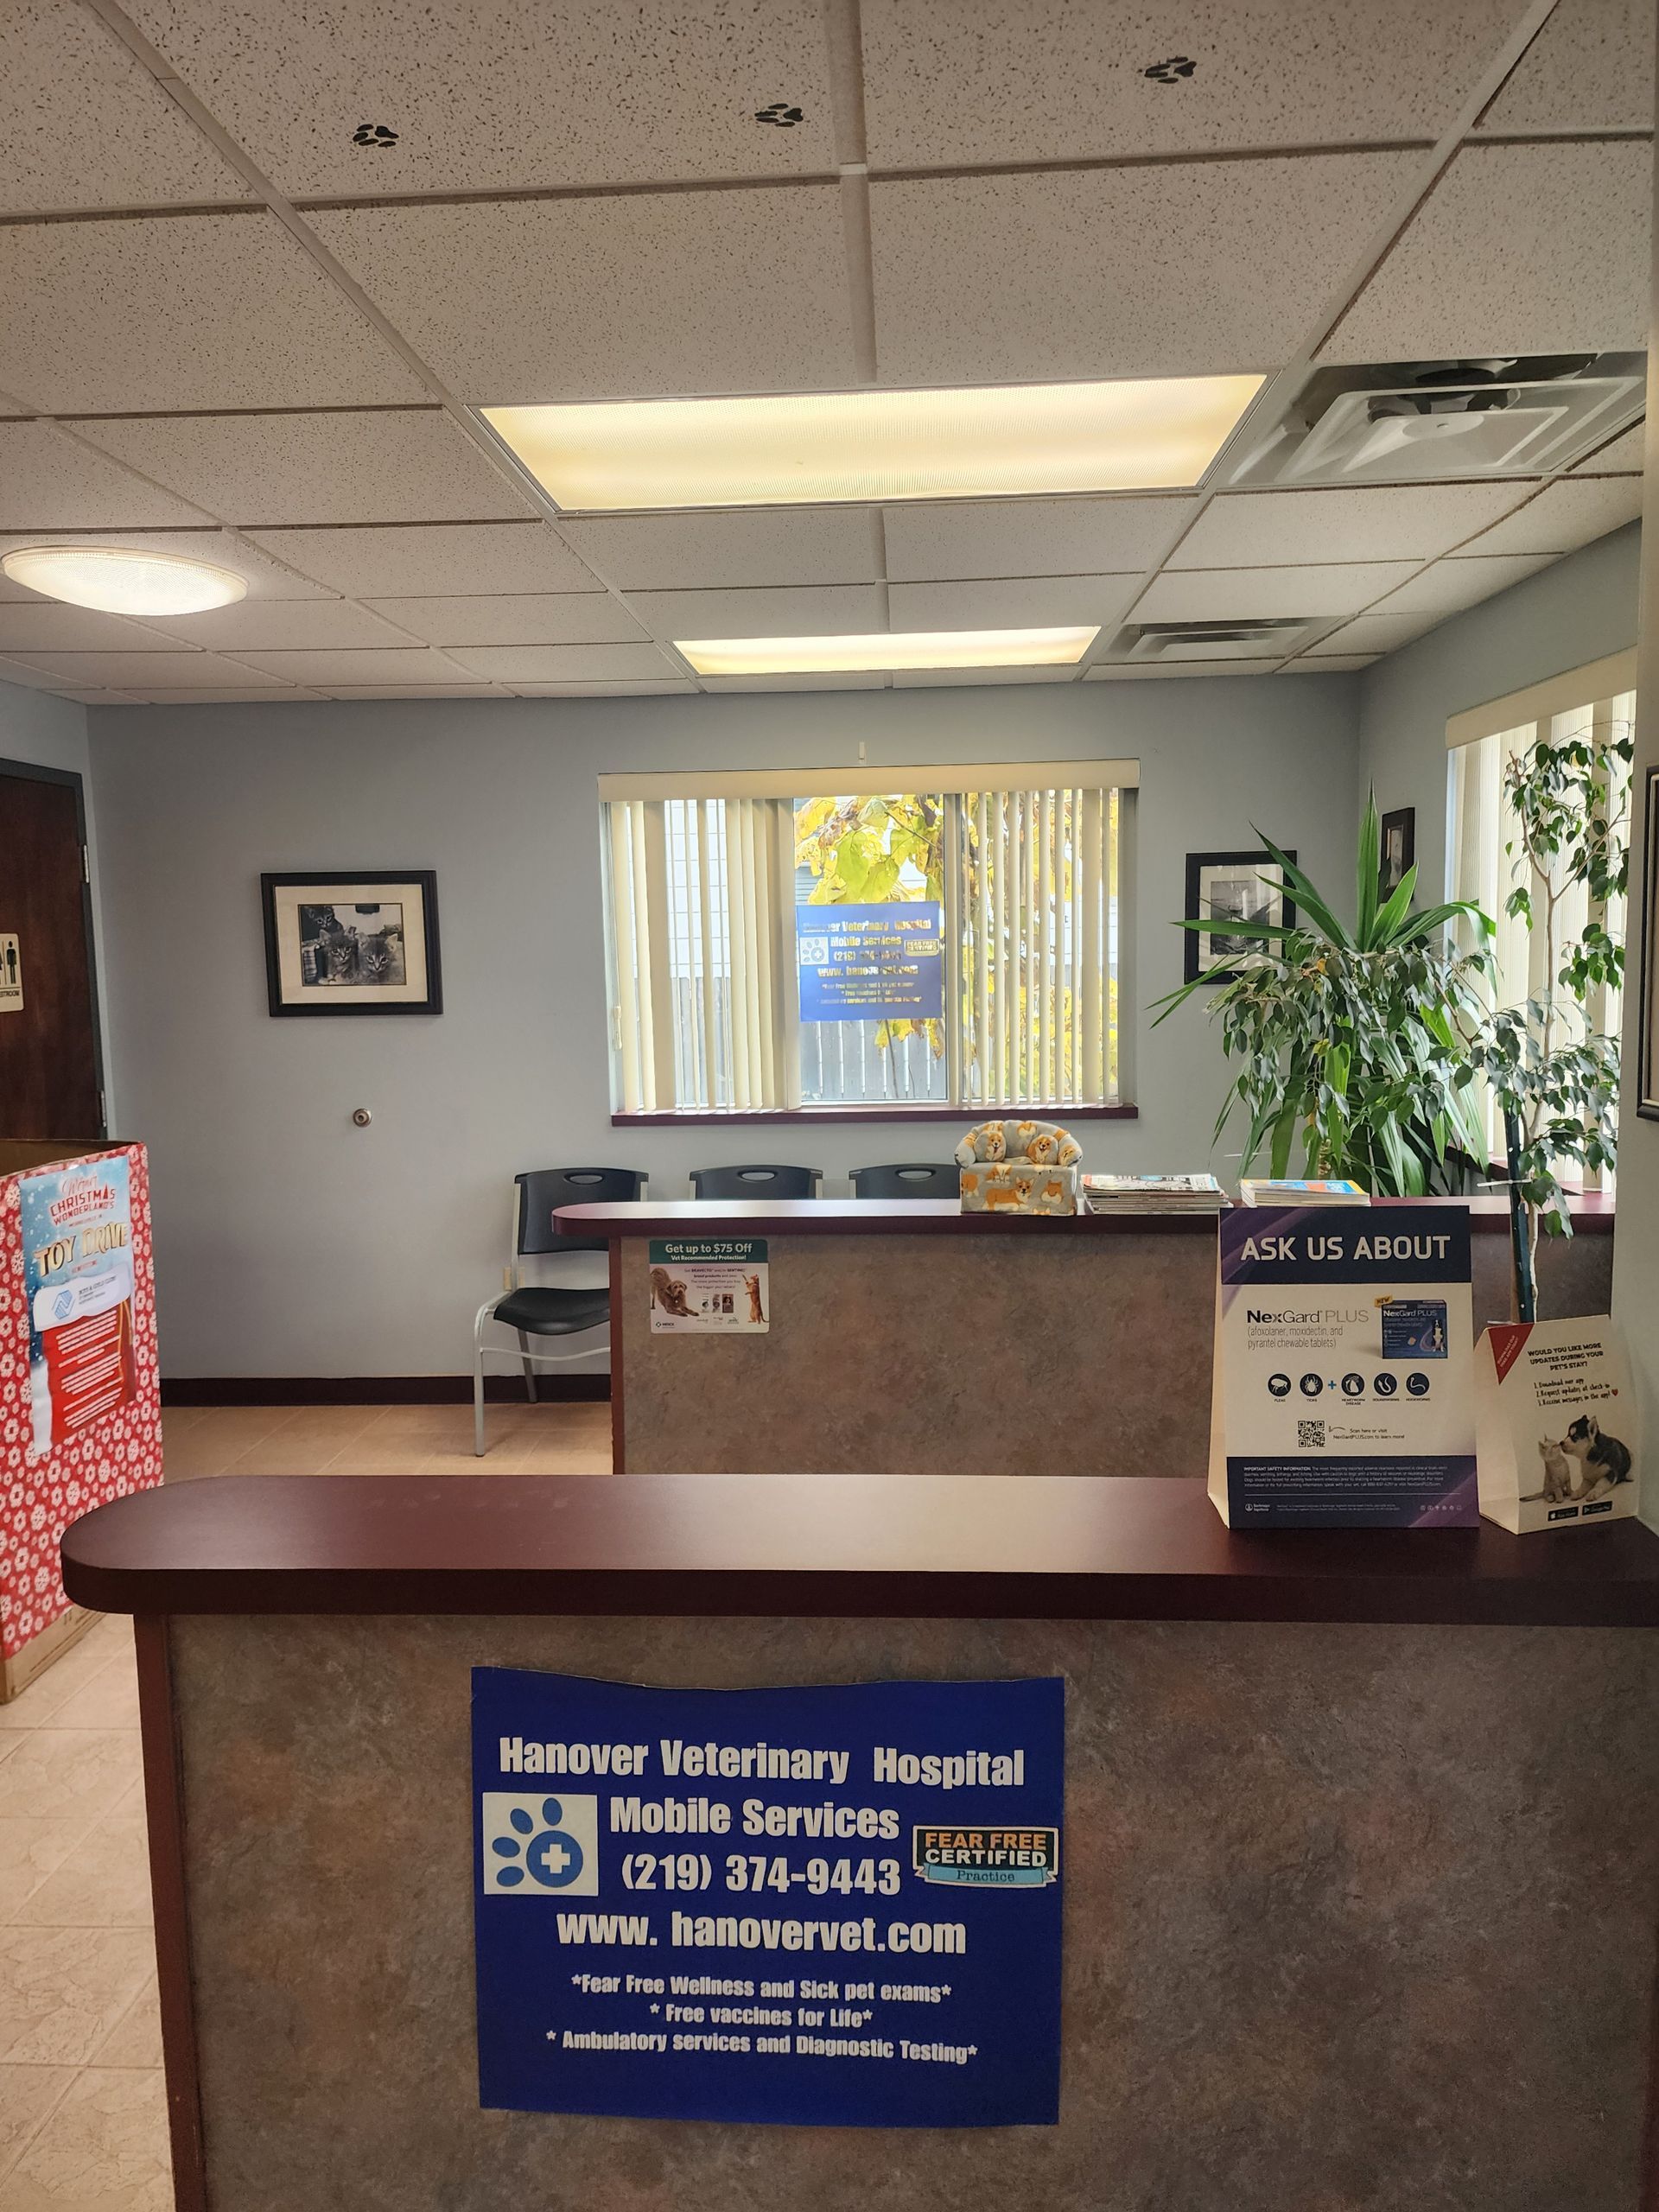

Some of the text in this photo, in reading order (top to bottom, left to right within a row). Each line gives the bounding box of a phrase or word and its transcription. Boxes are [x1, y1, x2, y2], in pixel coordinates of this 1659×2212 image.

[34, 1222, 128, 1277] TOY DRIVE
[665, 1243, 752, 1255] Get up to $75 Off
[1241, 1236, 1451, 1261] ASK US ABOUT
[1325, 1310, 1369, 1324] PLUS
[1331, 1326, 1344, 1336] and
[1248, 1338, 1337, 1350] pyrantel chewable tablets)
[1528, 1348, 1552, 1357] WOULD
[1529, 1356, 1560, 1365] UPDATES
[1560, 1352, 1585, 1361] DURING
[1539, 1379, 1563, 1389] Download
[1561, 1387, 1581, 1395] updates
[499, 1737, 1025, 1789] Hanover Veterinary Hospital
[610, 1796, 899, 1840] Mobile Services
[925, 1833, 1046, 1851] FEAR FREE
[925, 1849, 1046, 1866] CERTIFIED
[622, 1853, 900, 1895] (219) 374-9443
[957, 1870, 1015, 1882] Practice
[556, 1911, 967, 1954] www. hanovervet.com
[626, 1974, 665, 1994] Free
[671, 1976, 755, 1998] Wellness
[760, 1980, 795, 1998] and
[800, 1980, 839, 1999] Sick
[845, 1982, 874, 2001] pet
[665, 2004, 705, 2024] Free
[710, 2006, 792, 2026] vaccines
[798, 2007, 825, 2027] for
[563, 2031, 667, 2053] Ambulatory
[672, 2032, 751, 2053] services
[756, 2035, 791, 2054] and
[796, 2035, 894, 2058] Diagnostic
